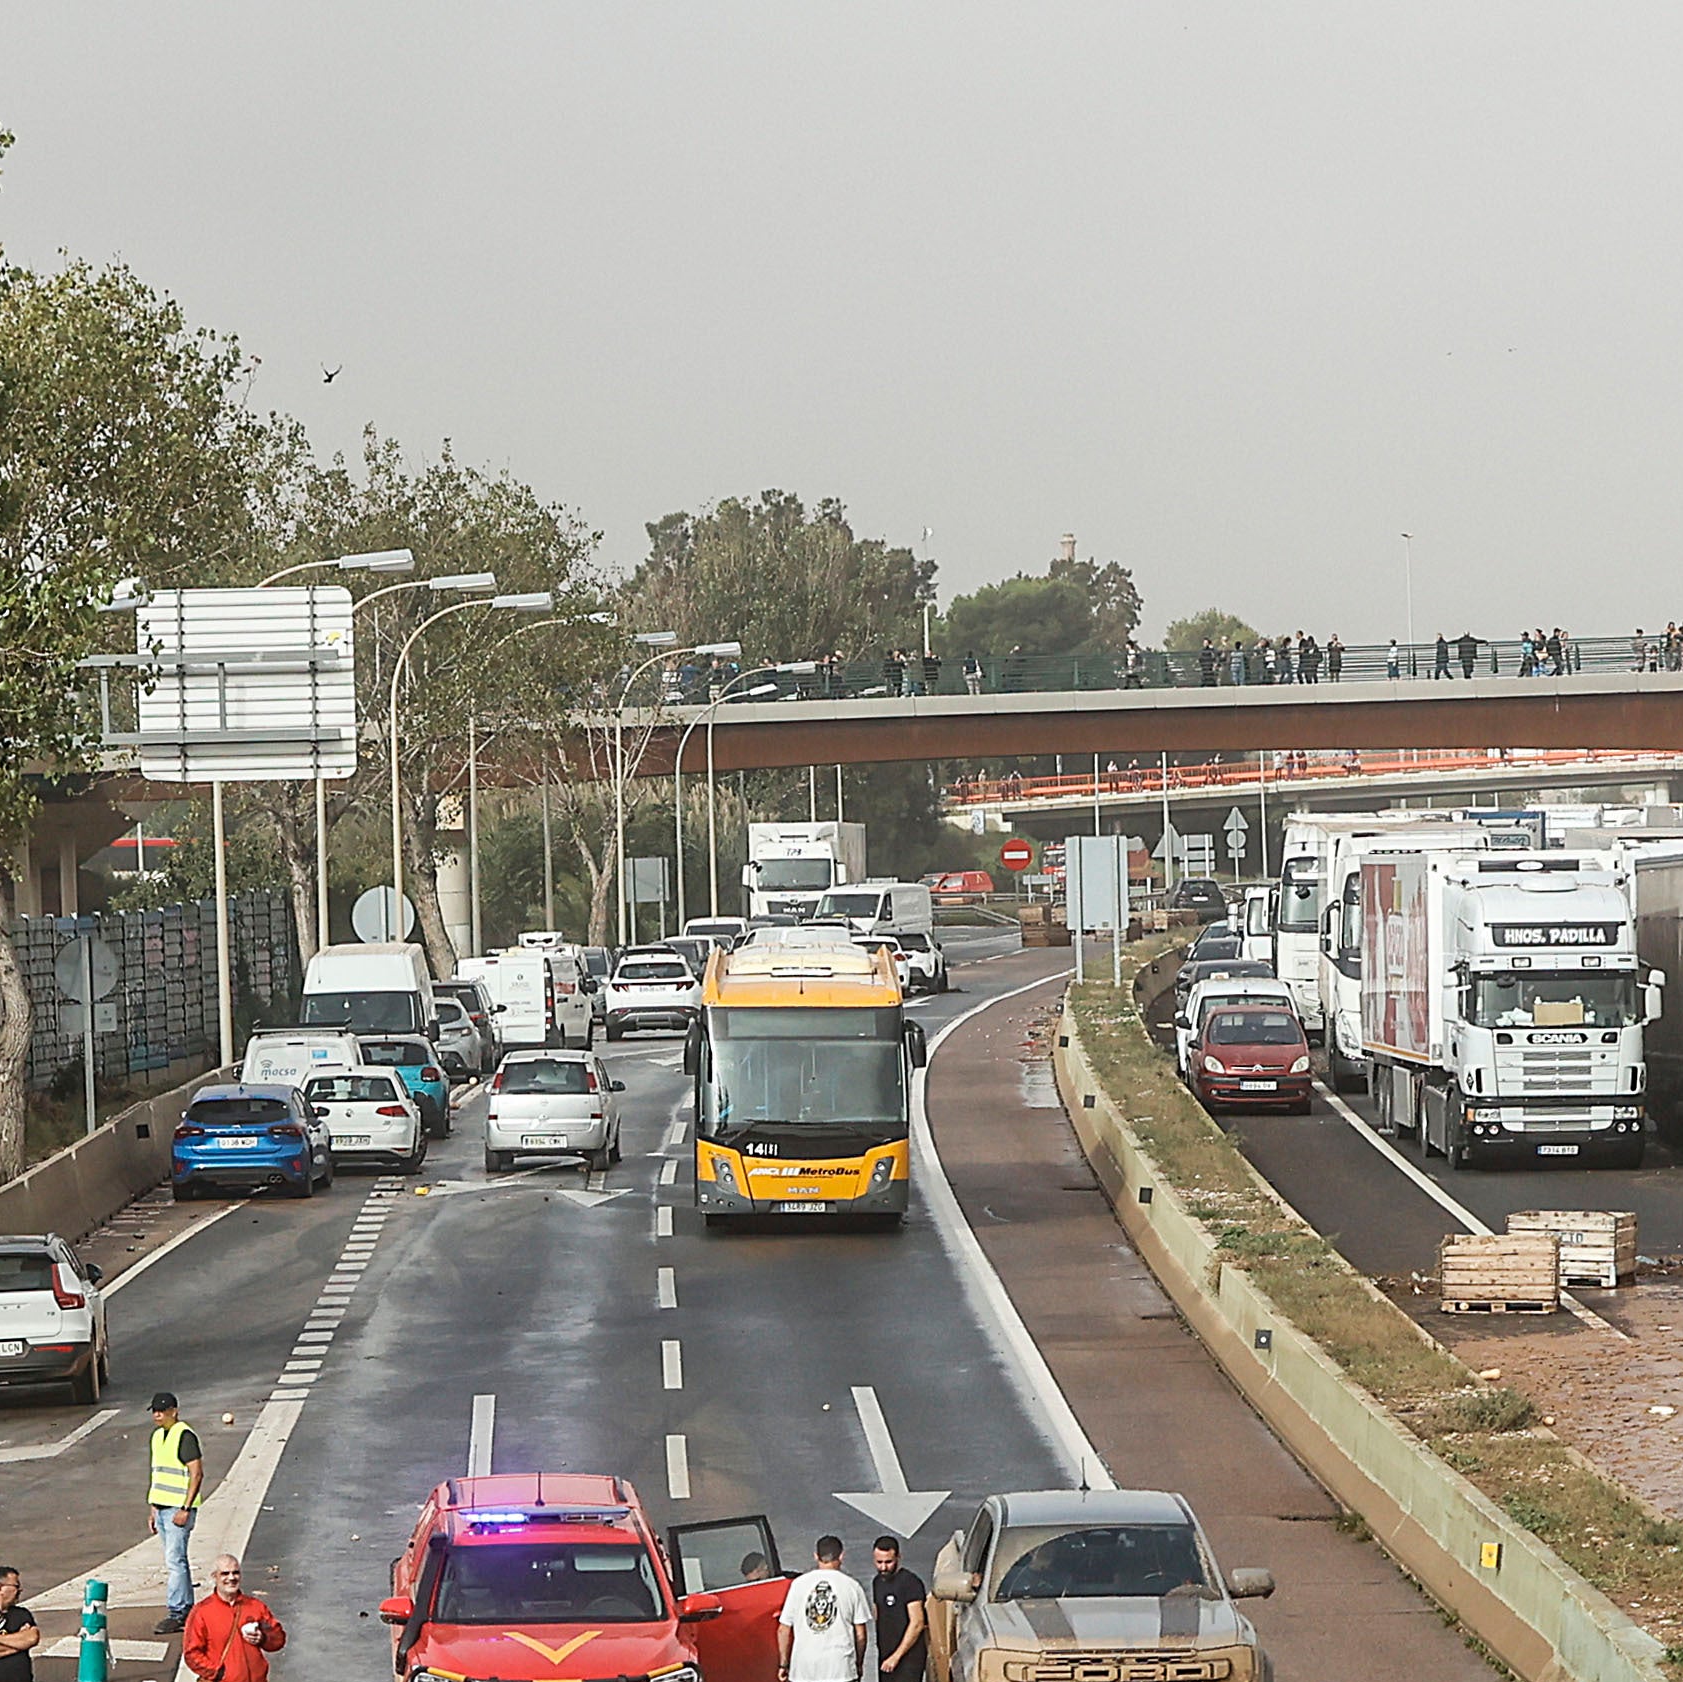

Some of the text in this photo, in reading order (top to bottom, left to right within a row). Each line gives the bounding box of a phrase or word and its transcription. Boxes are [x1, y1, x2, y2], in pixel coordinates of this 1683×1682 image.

[1504, 927, 1606, 944] HNOS. PADILLA
[1532, 1034, 1583, 1044] SCANIA
[799, 1167, 860, 1176] MetroBus
[787, 1186, 820, 1194] MAN
[2, 1343, 20, 1353] LCN
